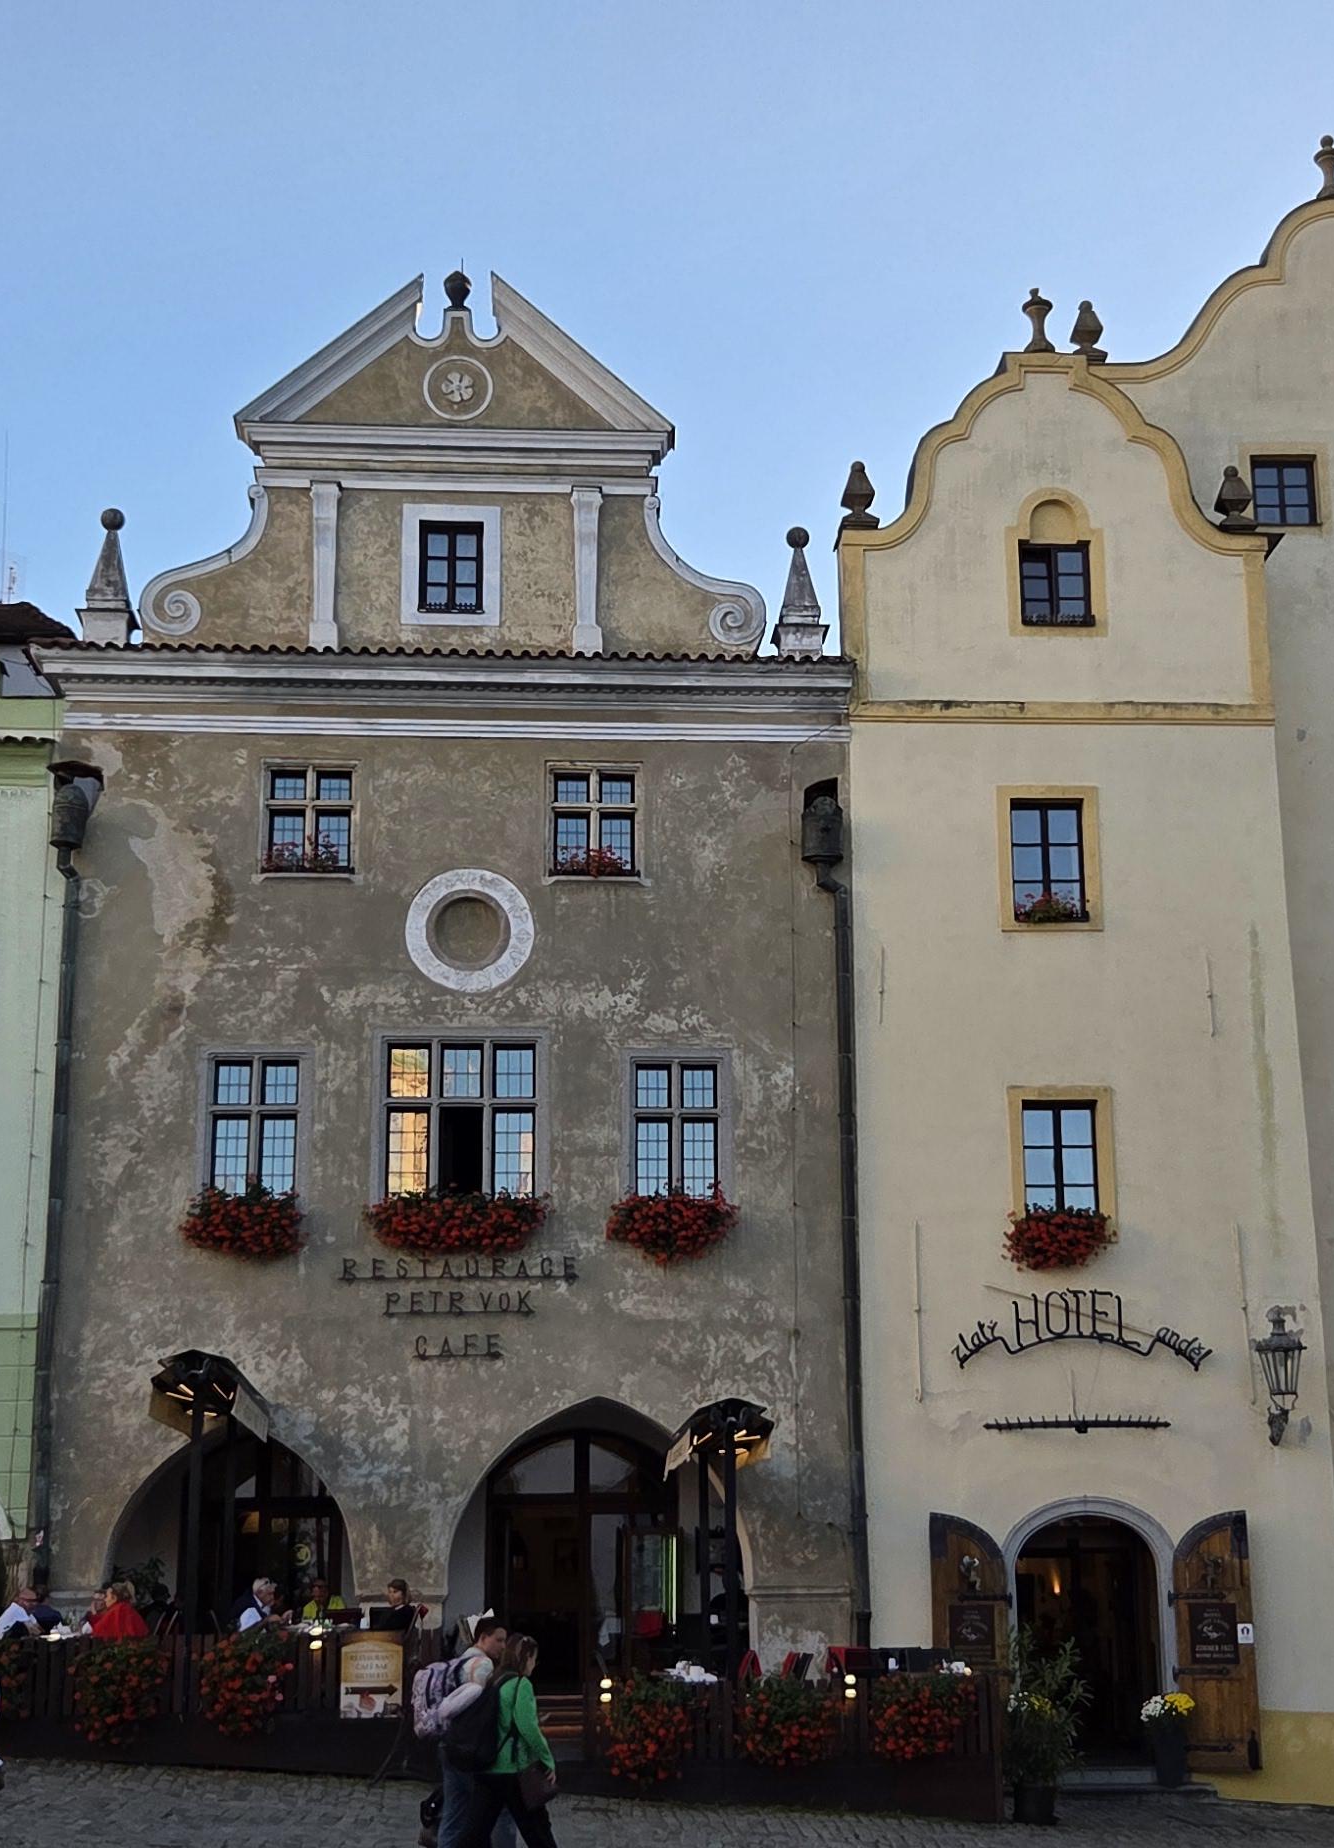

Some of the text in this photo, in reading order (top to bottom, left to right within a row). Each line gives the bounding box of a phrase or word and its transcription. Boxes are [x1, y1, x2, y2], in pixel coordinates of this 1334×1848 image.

[340, 1257, 578, 1280] RESTAURACE
[384, 1289, 535, 1315] PETR VOK
[1012, 1288, 1142, 1348] HOTEL
[414, 1333, 502, 1357] CAFE
